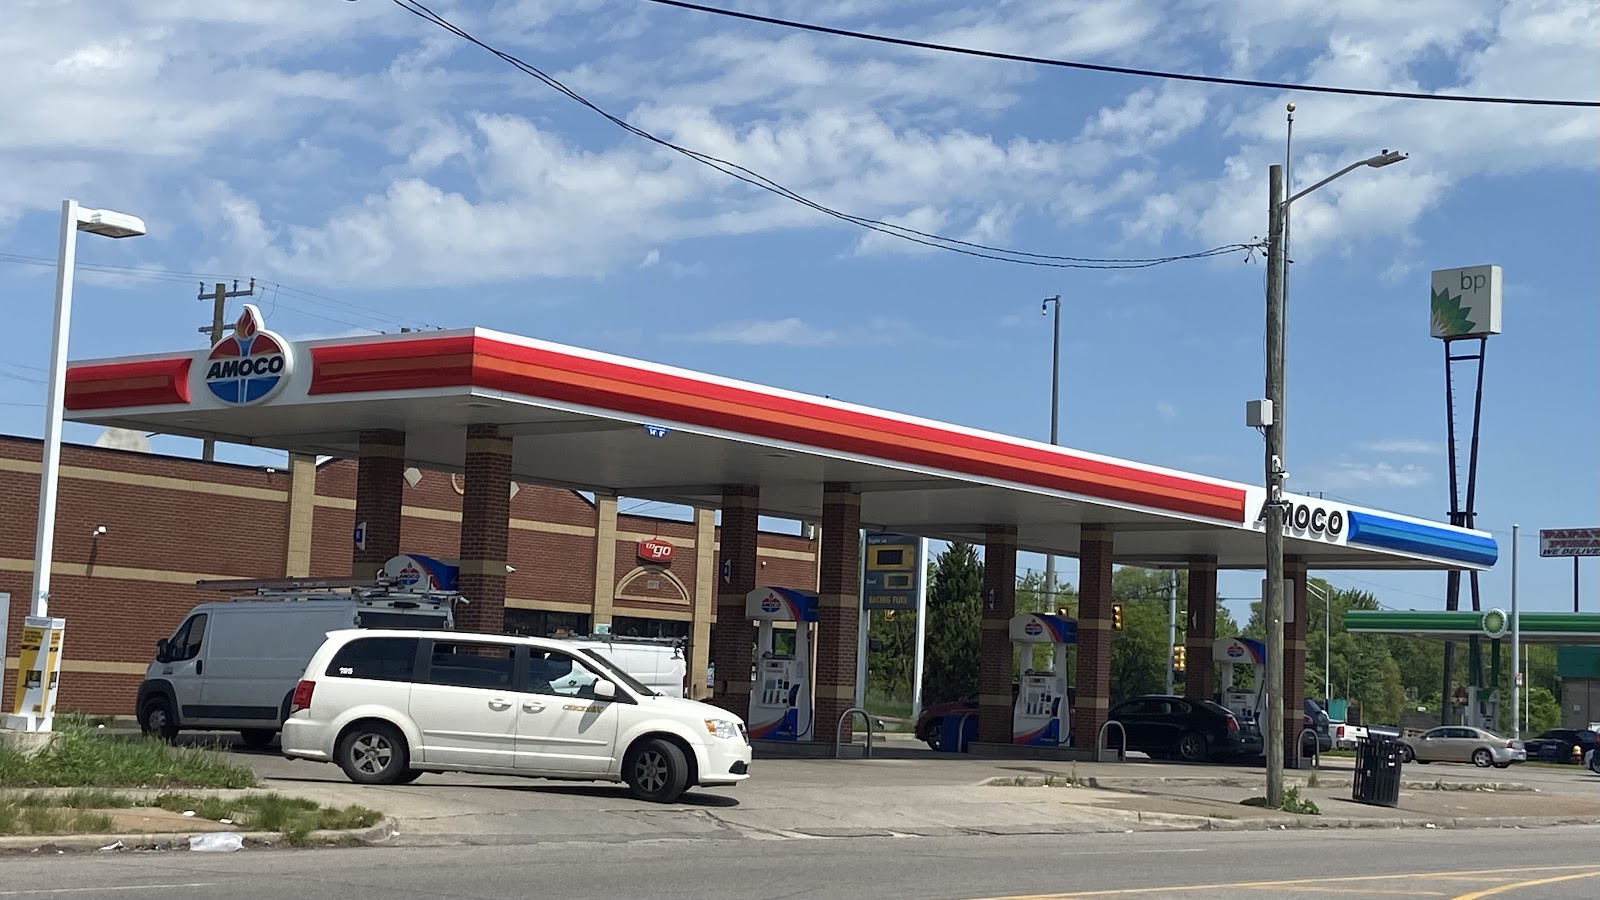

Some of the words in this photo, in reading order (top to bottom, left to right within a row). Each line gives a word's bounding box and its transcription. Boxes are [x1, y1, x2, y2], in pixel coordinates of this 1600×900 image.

[1460, 271, 1486, 294] bp
[206, 356, 284, 380] AMOCO
[1561, 547, 1600, 555] DELIVE
[868, 595, 891, 604] RACING
[892, 595, 908, 604] FUEL
